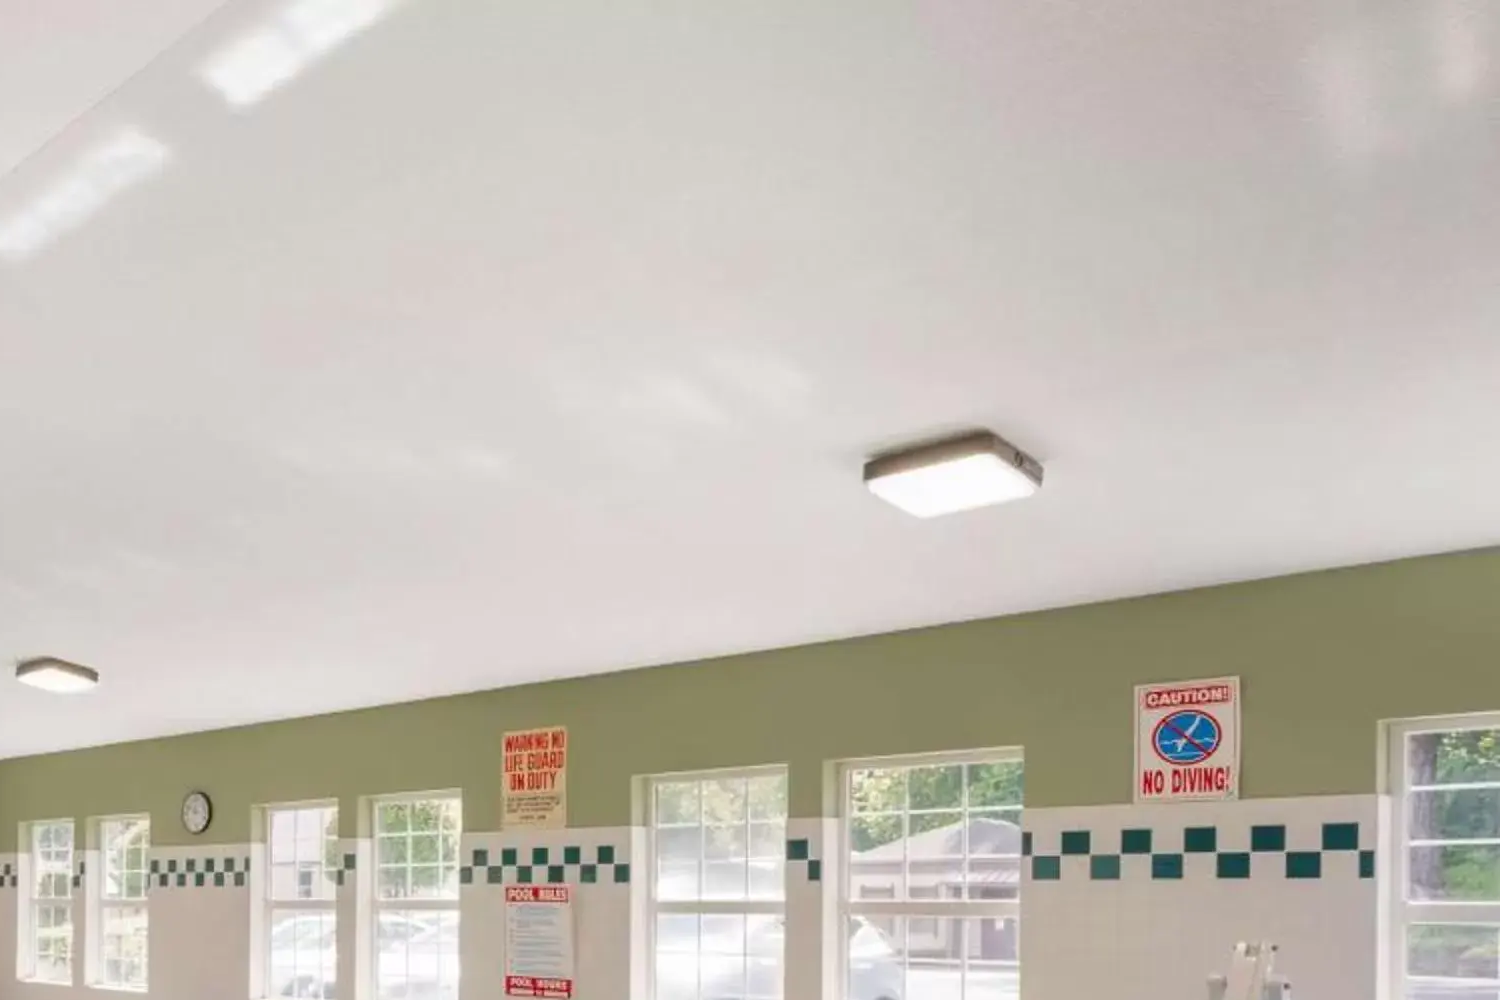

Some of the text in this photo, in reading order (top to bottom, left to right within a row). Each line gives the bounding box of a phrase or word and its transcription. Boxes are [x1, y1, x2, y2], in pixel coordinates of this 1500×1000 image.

[1147, 687, 1228, 706] CAUTION!
[505, 731, 565, 752] WARNING NO
[505, 751, 564, 772] LIFE GUARD
[510, 771, 557, 790] ON DUTY
[1143, 766, 1230, 795] NO DIVING!
[507, 887, 532, 900] POOL
